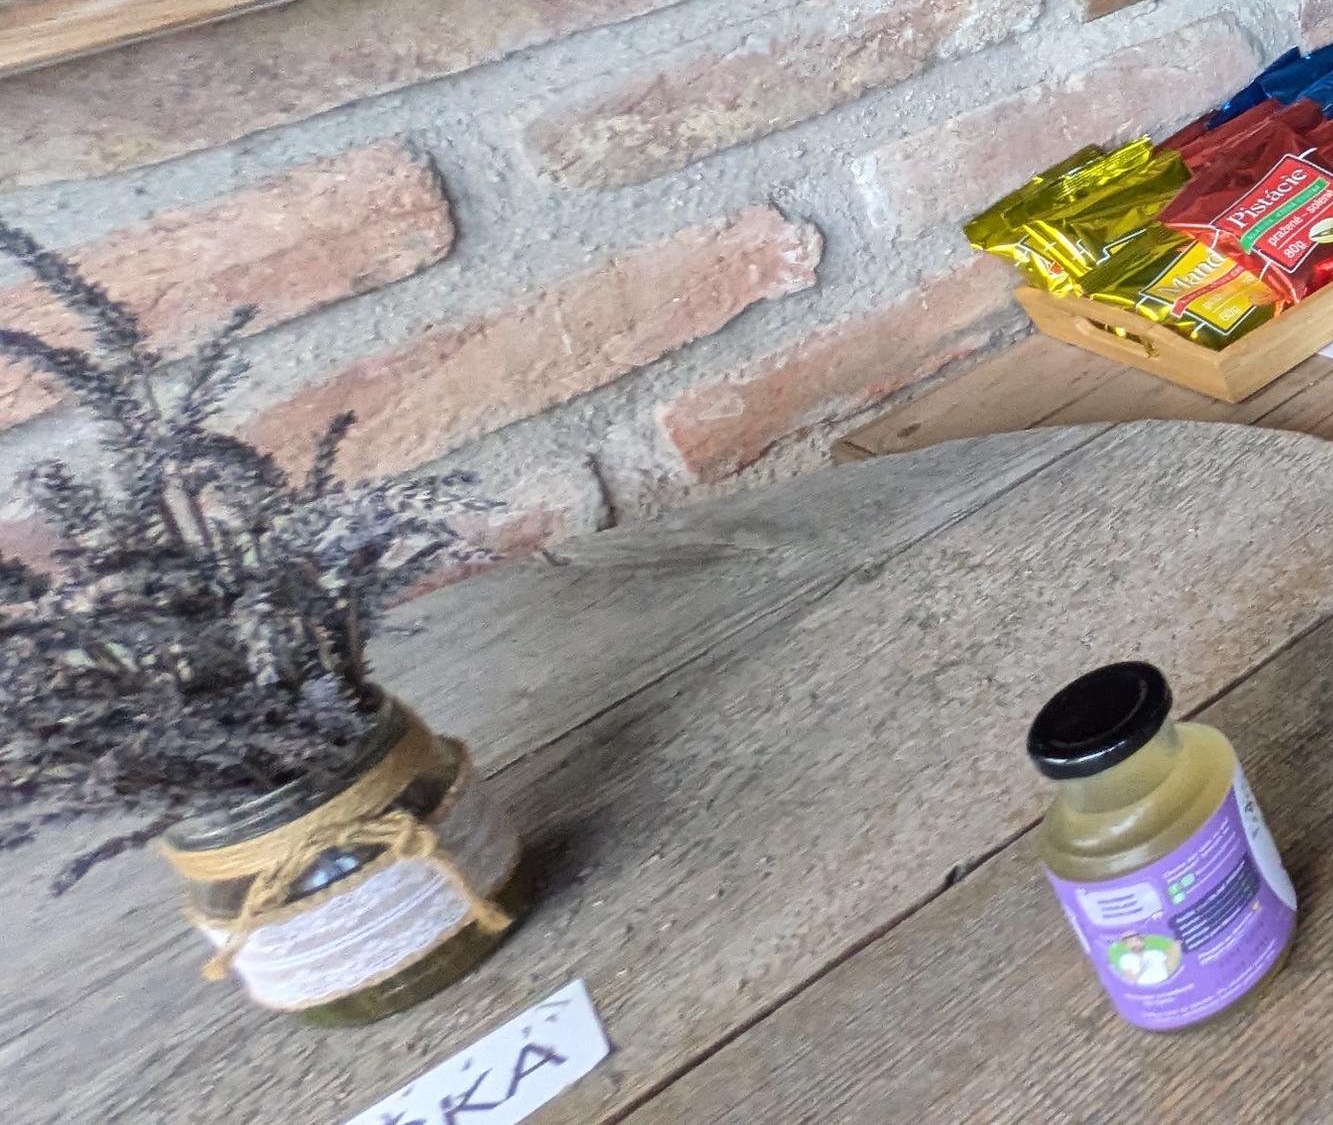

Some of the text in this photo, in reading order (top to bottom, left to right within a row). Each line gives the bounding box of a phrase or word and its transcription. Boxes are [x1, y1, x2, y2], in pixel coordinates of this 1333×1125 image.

[1227, 168, 1308, 229] Pistácie
[1267, 215, 1304, 247] pražené
[1284, 240, 1307, 259] 80g
[1159, 248, 1226, 293] Mand
